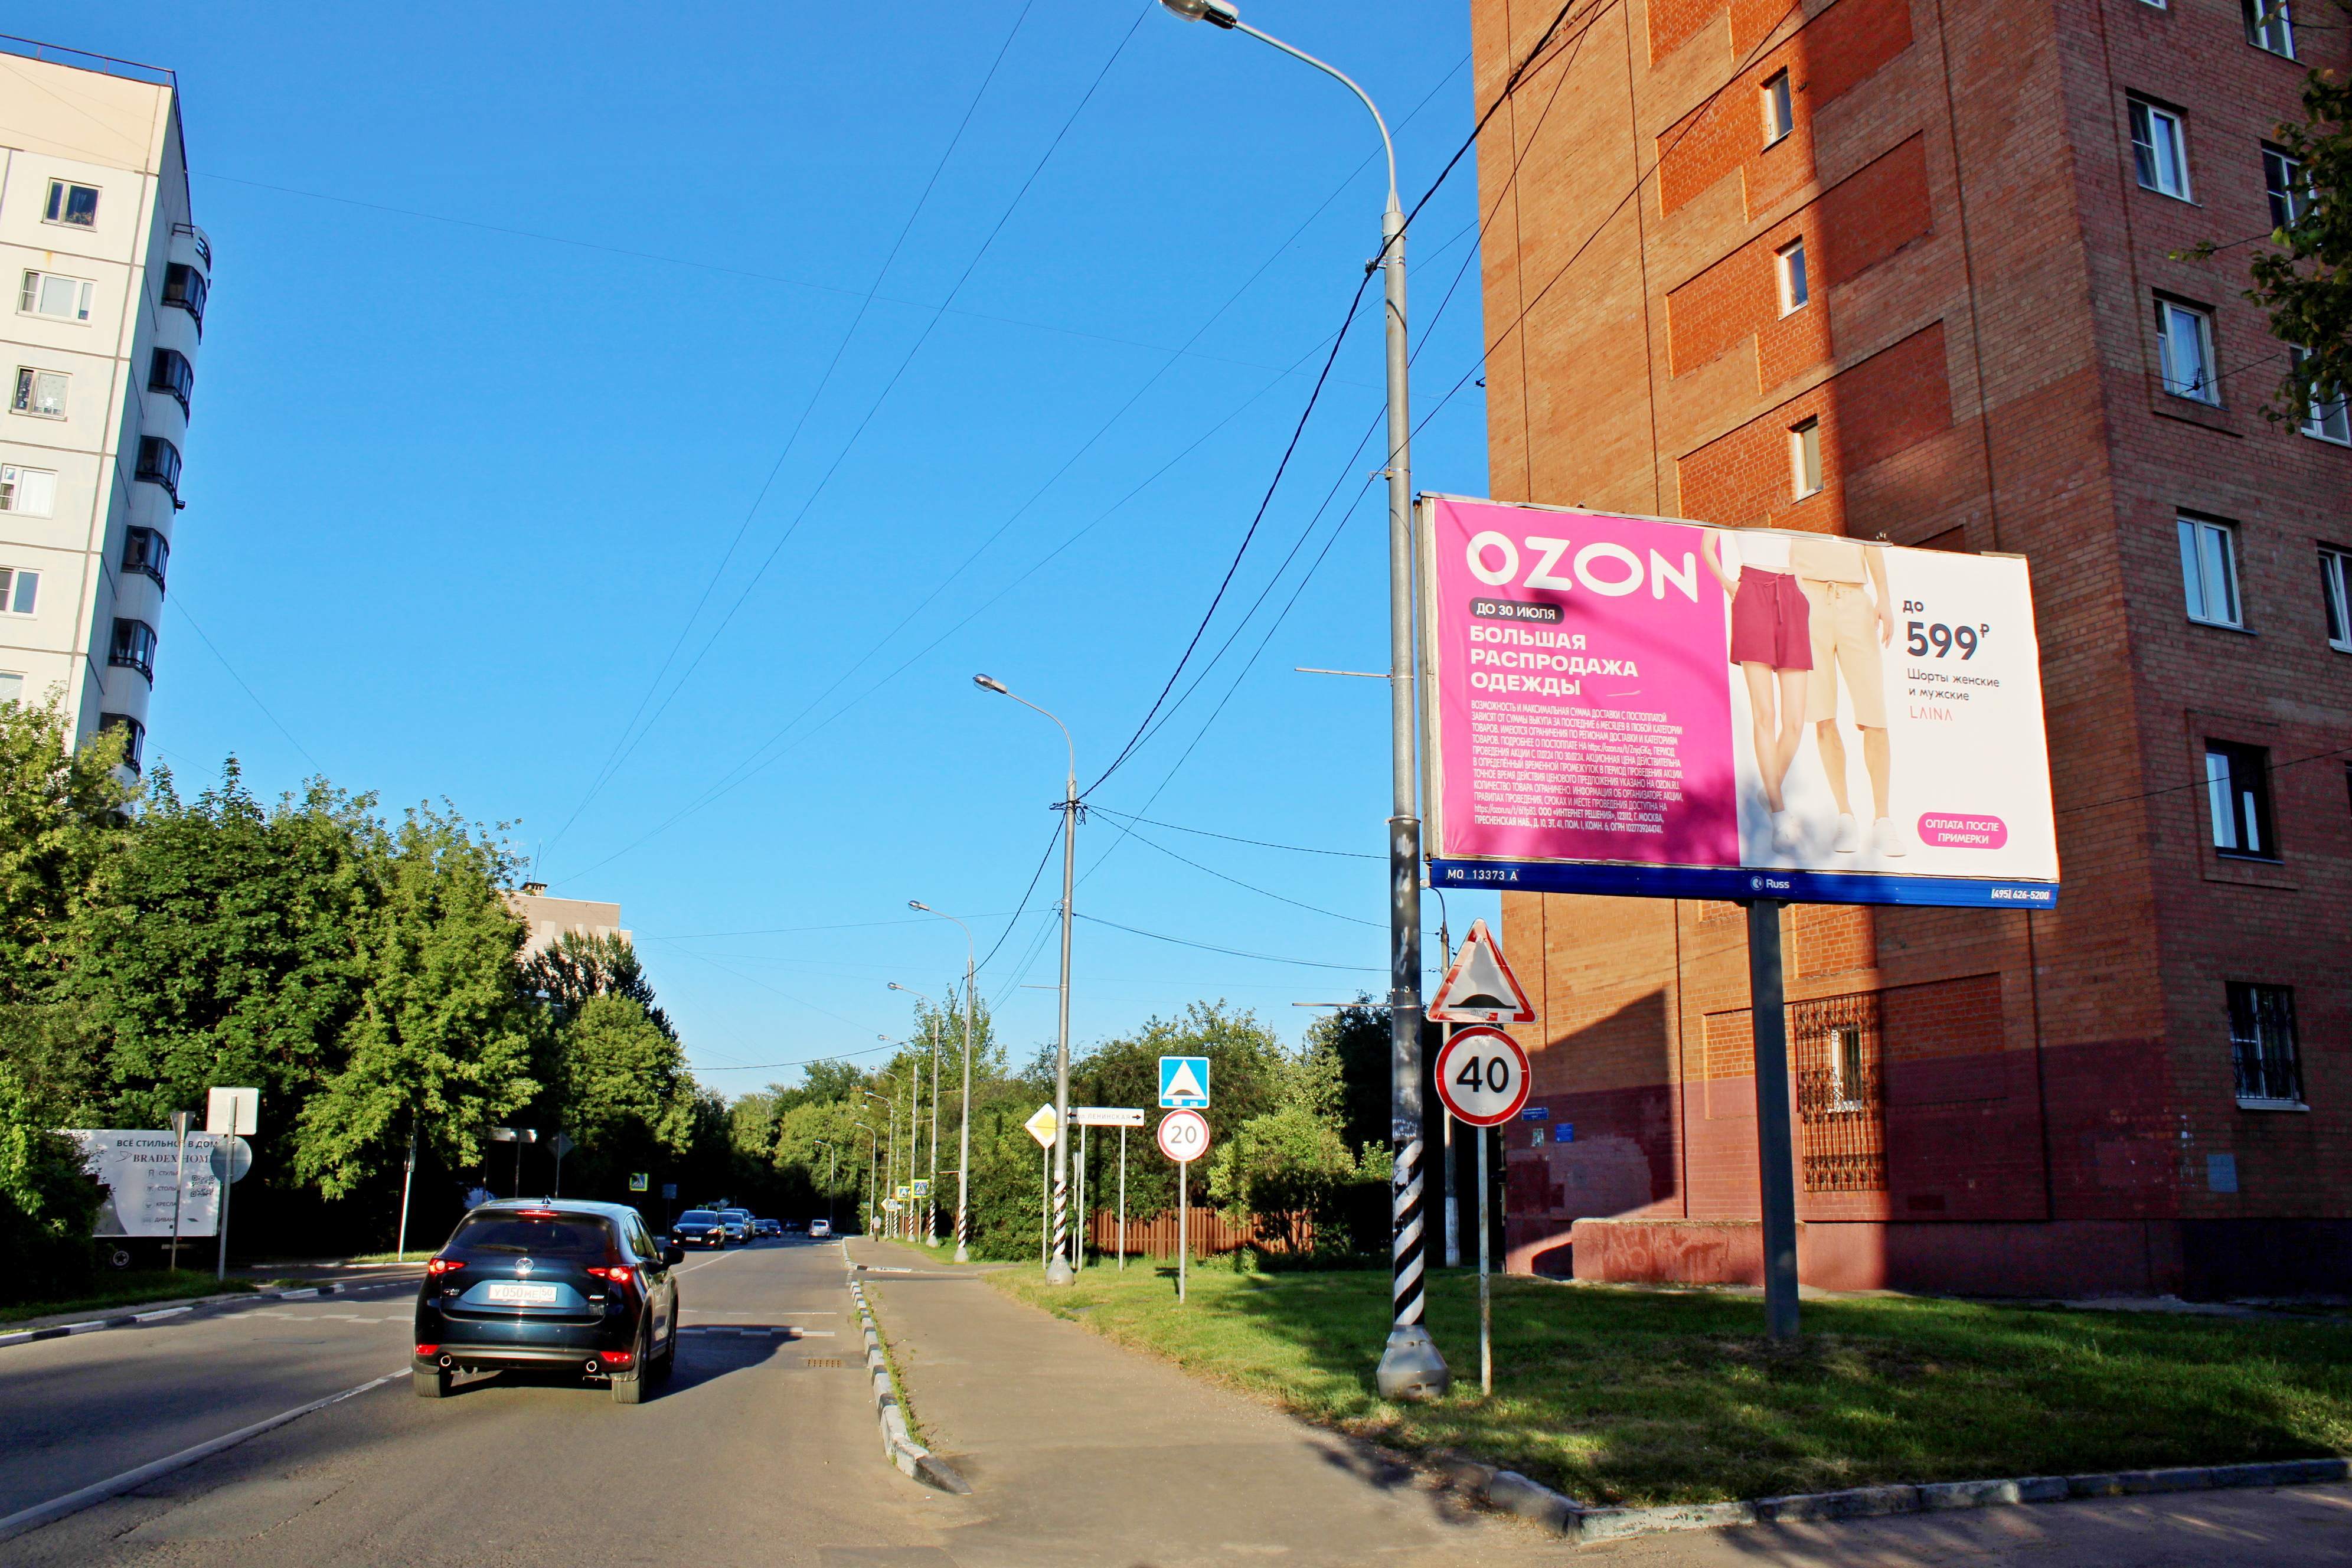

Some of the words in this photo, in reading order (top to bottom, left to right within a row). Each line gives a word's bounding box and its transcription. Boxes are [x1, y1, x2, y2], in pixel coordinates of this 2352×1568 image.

[1466, 530, 1699, 603] OZON
[1476, 602, 1495, 616] ДО
[1498, 605, 1514, 617] 30
[1516, 606, 1556, 620] ИЮЛЯ
[1470, 625, 1586, 651] БОЛЬШАЯ
[1471, 648, 1639, 677] РАСПРОДАЖА
[1471, 671, 1580, 696] ОДЕЖДЫ
[1907, 668, 1948, 683] Шорты
[1952, 674, 2000, 687] женские
[1909, 688, 1916, 696] и
[1919, 688, 1969, 701] мужские
[1471, 700, 1515, 711] ВОЗМОЖНОСТЬ
[1517, 704, 1521, 712] И
[1523, 704, 1569, 715] МАКСИМАЛЬНАЯ
[1570, 707, 1590, 717] СУММА
[1592, 709, 1620, 720] ДОСТАВКИ
[1621, 711, 1625, 719] С
[1626, 710, 1667, 722] ПОСТОПЛАТОЙ
[1471, 711, 1496, 721] ЗАВИСЯТ
[1497, 713, 1504, 721] ОТ
[1506, 714, 1527, 723] СУММЫ
[1529, 716, 1551, 725] ВЫКУПА
[1553, 717, 1560, 726] ЗА
[1562, 718, 1595, 730] ПОСЛЕДНИЕ
[1600, 720, 1625, 731] МЕСЯЦЕВ
[1626, 722, 1629, 730] В
[1631, 721, 1652, 732] ЛЮБОЙ
[1653, 724, 1682, 734] КАТЕГОРИИ
[1500, 724, 1527, 734] ИМЕЮТСЯ
[1529, 726, 1567, 737] ОГРАНИЧЕНИЯ
[1569, 729, 1577, 738] ПО
[1579, 730, 1608, 740] РЕГИОНАМ
[1609, 732, 1638, 743] ДОСТАВКИ
[1639, 734, 1643, 742] И
[1644, 734, 1677, 744] КАТЕГОРИЯМ
[1501, 736, 1534, 747] ПОДРОБНЕЕ
[1535, 739, 1540, 747] О
[1541, 739, 1577, 749] ПОСТОПЛАТЕ
[1579, 741, 1586, 750] НА
[1653, 746, 1674, 757] ПЕРИОД
[1473, 746, 1509, 757] ПРОВЕДЕНИЯ
[1510, 748, 1530, 759] АКЦИИ
[1554, 751, 1563, 759] ПО
[1586, 753, 1619, 765] АКЦИОННАЯ
[1621, 756, 1635, 765] ЦЕНА
[1636, 755, 1681, 768] ДЕЙСТВИТЕЛЬНА
[1473, 757, 1476, 766] В
[1478, 756, 1523, 770] ОПРЕДЕЛЁННЫЙ
[1524, 759, 1558, 770] ВРЕМЕННОЙ
[1560, 763, 1598, 773] ПРОМЕЖУТОК
[1600, 765, 1603, 773] В
[1605, 765, 1626, 776] ПЕРИОД
[1627, 767, 1662, 778] ПРОВЕДЕНИЯ
[1473, 769, 1496, 778] ТОЧНОЕ
[1497, 770, 1515, 779] ВРЕМЯ
[1516, 770, 1544, 782] ДЕЙСТВИЯ
[1546, 773, 1576, 784] ЦЕНОВОГО
[1577, 775, 1618, 787] ПРЕДЛОЖЕНИЯ
[1619, 778, 1645, 787] УКАЗАНО
[1647, 779, 1654, 788] НА
[1474, 780, 1511, 790] КОЛИЧЕСТВО
[1512, 782, 1533, 792] ТОВАРА
[1573, 786, 1612, 798] ИНФОРМАЦИЯ
[1613, 789, 1621, 797] ОБ
[1622, 789, 1662, 799] ОРГАНИЗАТОРЕ
[1474, 792, 1504, 802] ПРАВИЛАХ
[1544, 796, 1566, 805] СРОКАХ
[1568, 797, 1572, 805] И
[1573, 798, 1590, 806] МЕСТЕ
[1592, 799, 1627, 810] ПРОВЕДЕНИЯ
[1628, 801, 1658, 811] ДОСТУПНА
[1660, 802, 1667, 811] НА
[1538, 807, 1551, 816] ООО
[1553, 808, 1583, 817] «ИНТЕРНЕТ
[1475, 815, 1516, 825] ПРЕСНЕНСКАЯ
[1610, 822, 1624, 831] ОГРН
[1925, 818, 1964, 832] ОПЛАТА
[1966, 821, 1999, 832] ПОСЛЕ
[1938, 832, 1989, 845] ПРИМЕРКИ
[1472, 869, 1505, 880] 13373
[1766, 878, 1790, 888] Russ
[2013, 890, 2050, 900] 626-5200
[1456, 1056, 1510, 1093] 40
[117, 1138, 134, 1147] ВСЁ
[1170, 1125, 1197, 1144] 20
[133, 1154, 177, 1162] BRADEX
[541, 1288, 553, 1296] 50
